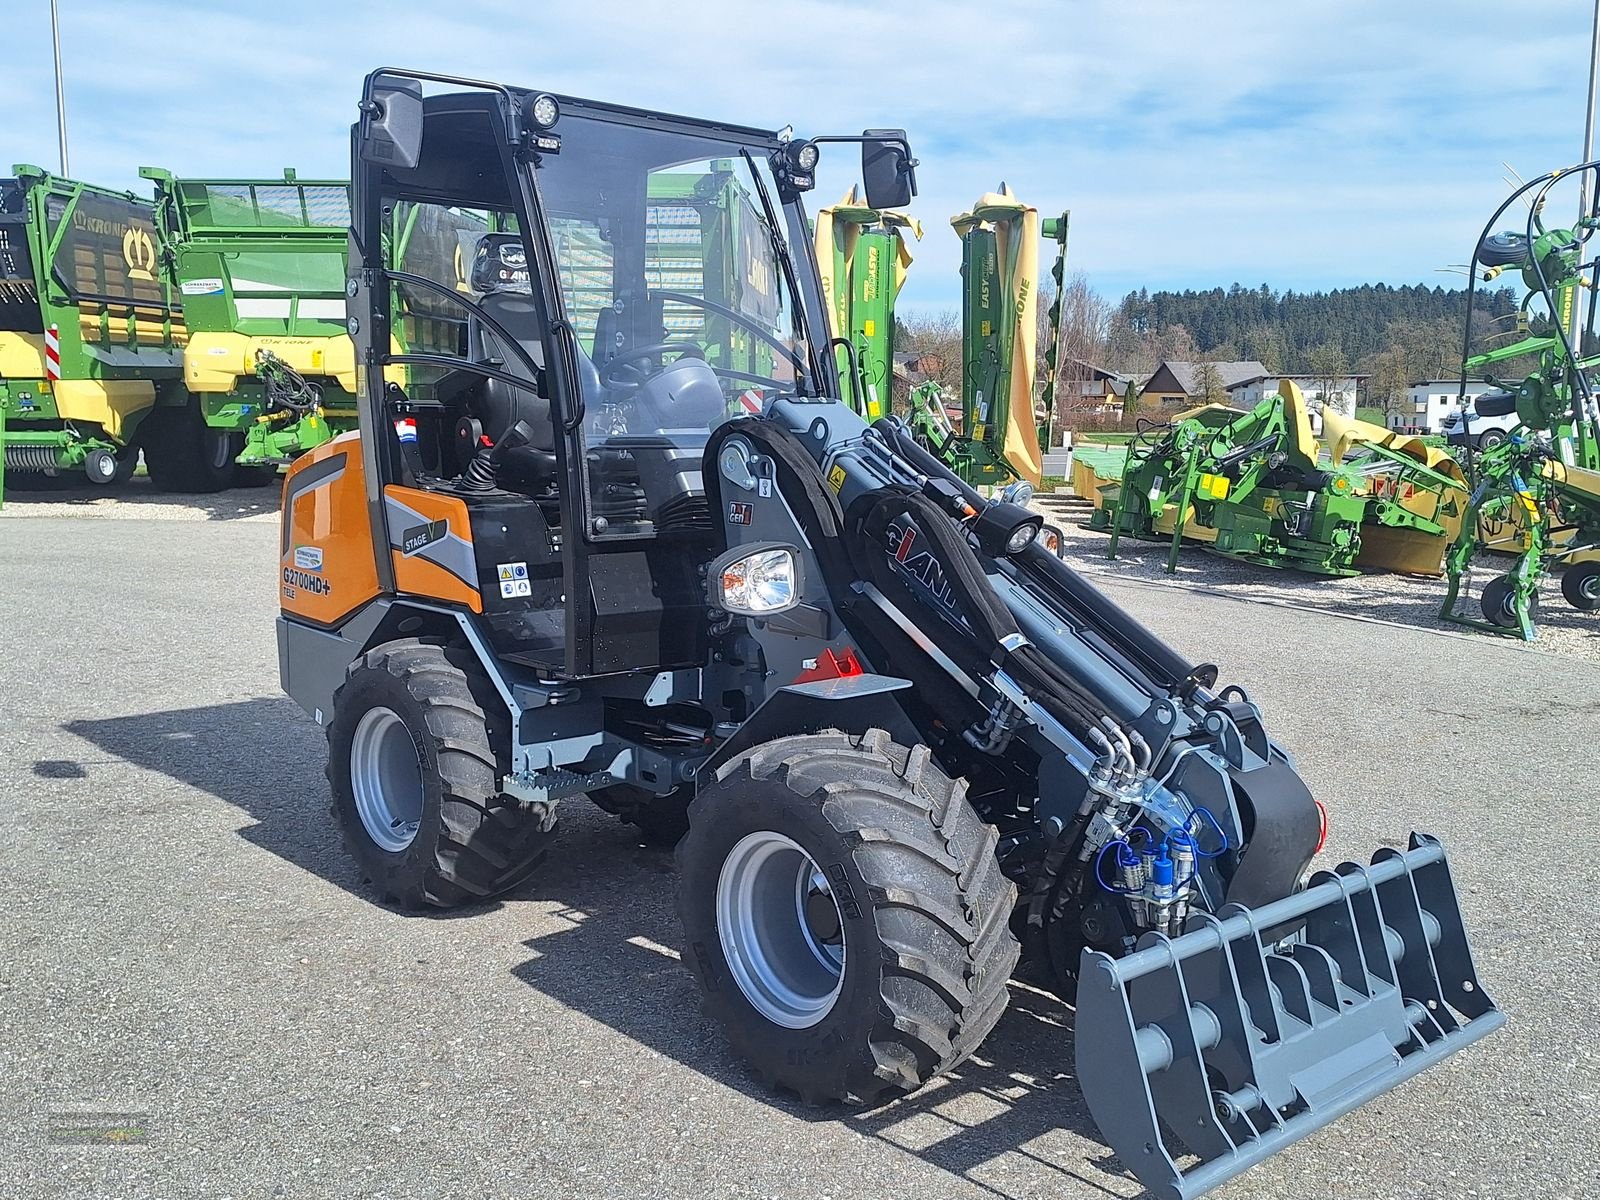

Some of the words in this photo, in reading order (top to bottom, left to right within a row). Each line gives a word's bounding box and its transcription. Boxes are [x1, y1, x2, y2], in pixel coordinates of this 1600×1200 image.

[405, 532, 428, 551] STAGE
[885, 522, 957, 609] GIAN
[283, 566, 331, 596] G2700HD+
[283, 586, 296, 600] TELE
